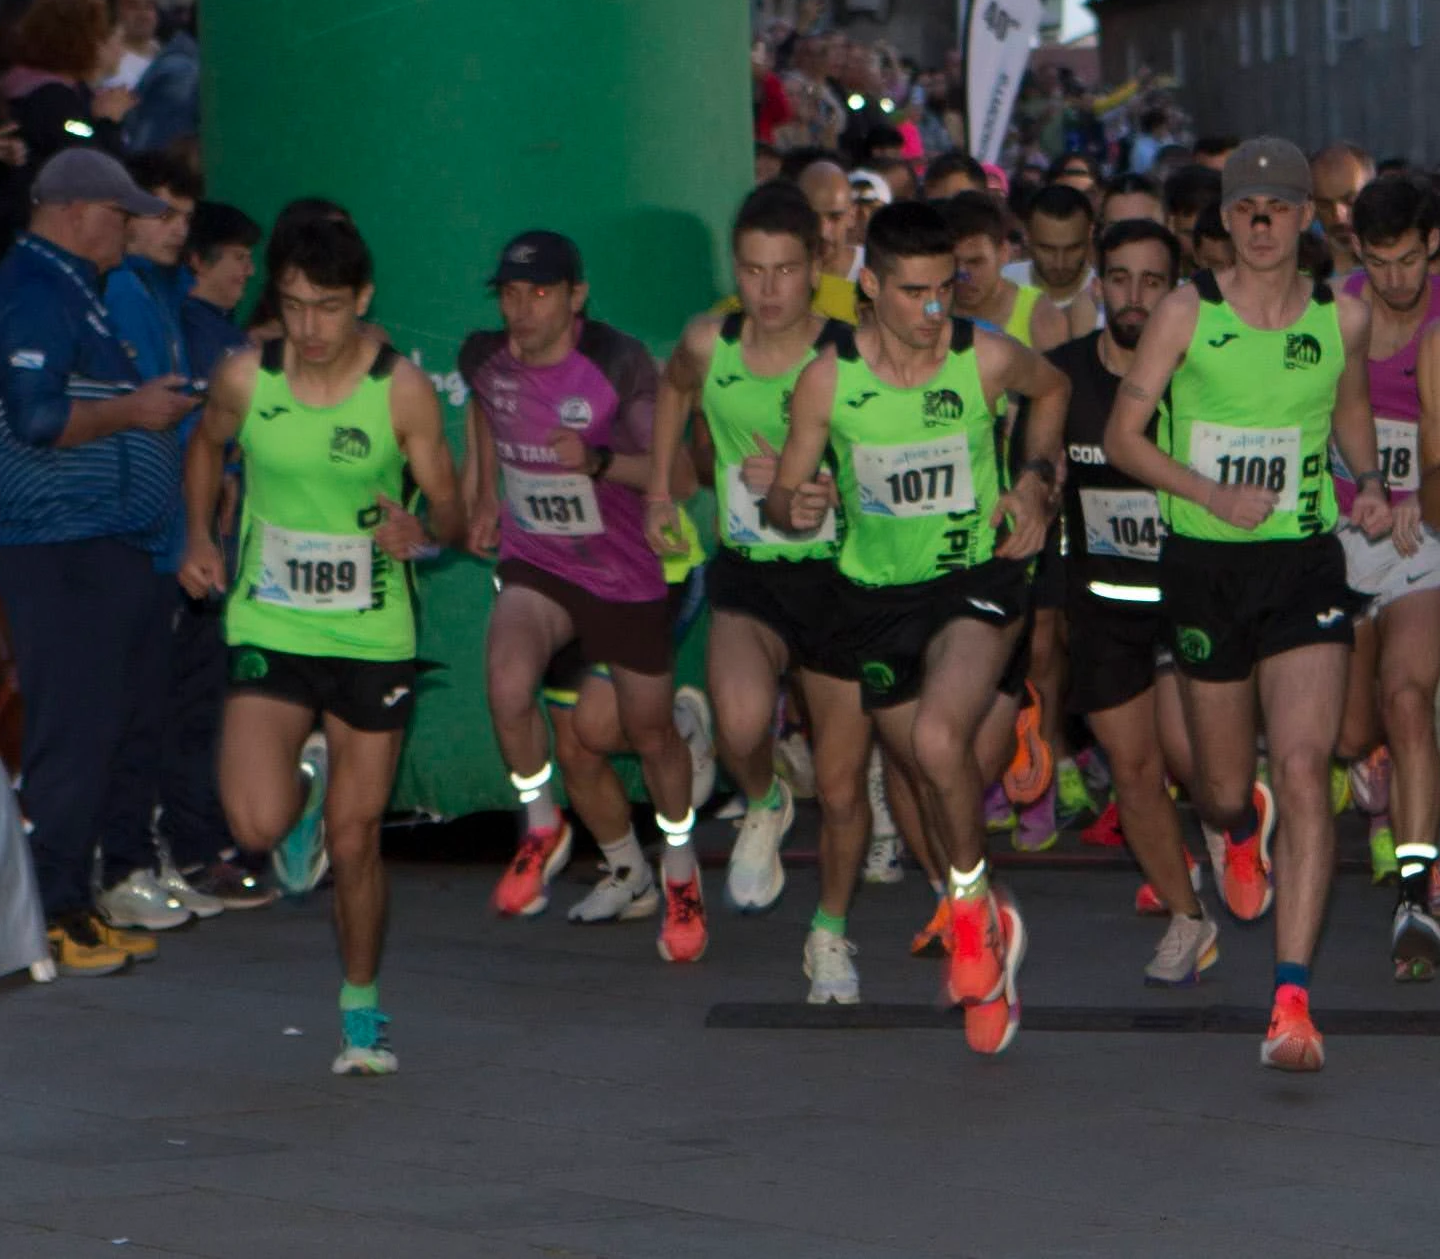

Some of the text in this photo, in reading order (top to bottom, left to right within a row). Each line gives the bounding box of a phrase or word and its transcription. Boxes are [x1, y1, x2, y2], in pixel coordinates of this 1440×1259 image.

[885, 463, 955, 505] 1077
[1216, 454, 1287, 492] 1108
[525, 494, 586, 523] 1131
[1106, 516, 1166, 548] 104
[284, 557, 357, 595] 1189
